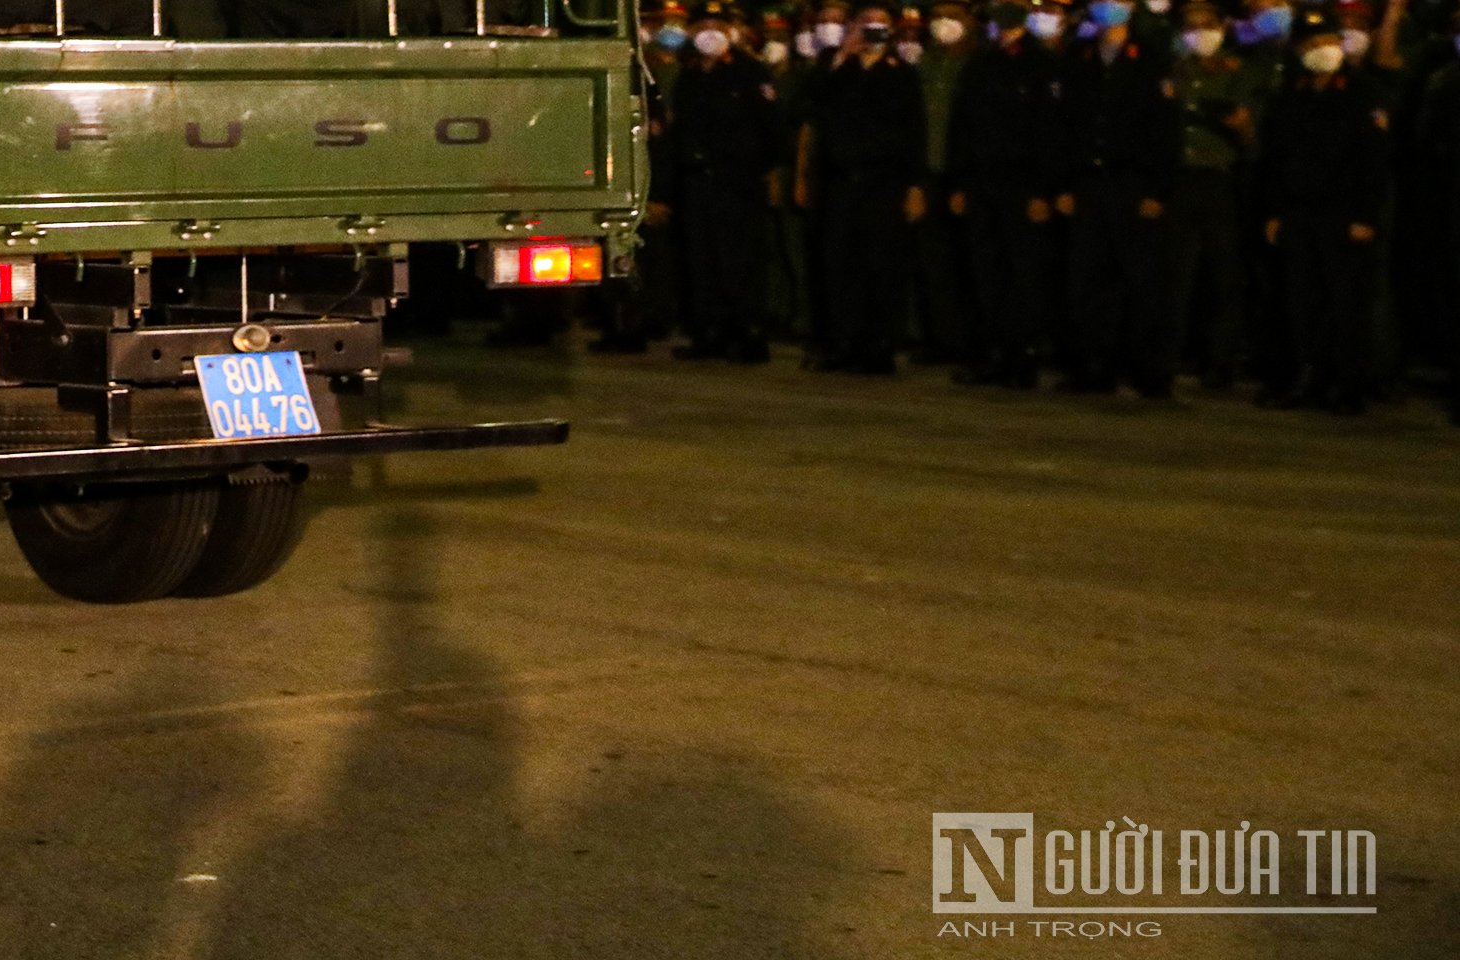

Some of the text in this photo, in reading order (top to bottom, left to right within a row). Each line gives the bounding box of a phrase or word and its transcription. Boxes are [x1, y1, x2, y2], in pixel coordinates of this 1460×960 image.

[55, 116, 491, 151] FUSO
[222, 354, 283, 395] 80A
[211, 394, 314, 437] 044.76
